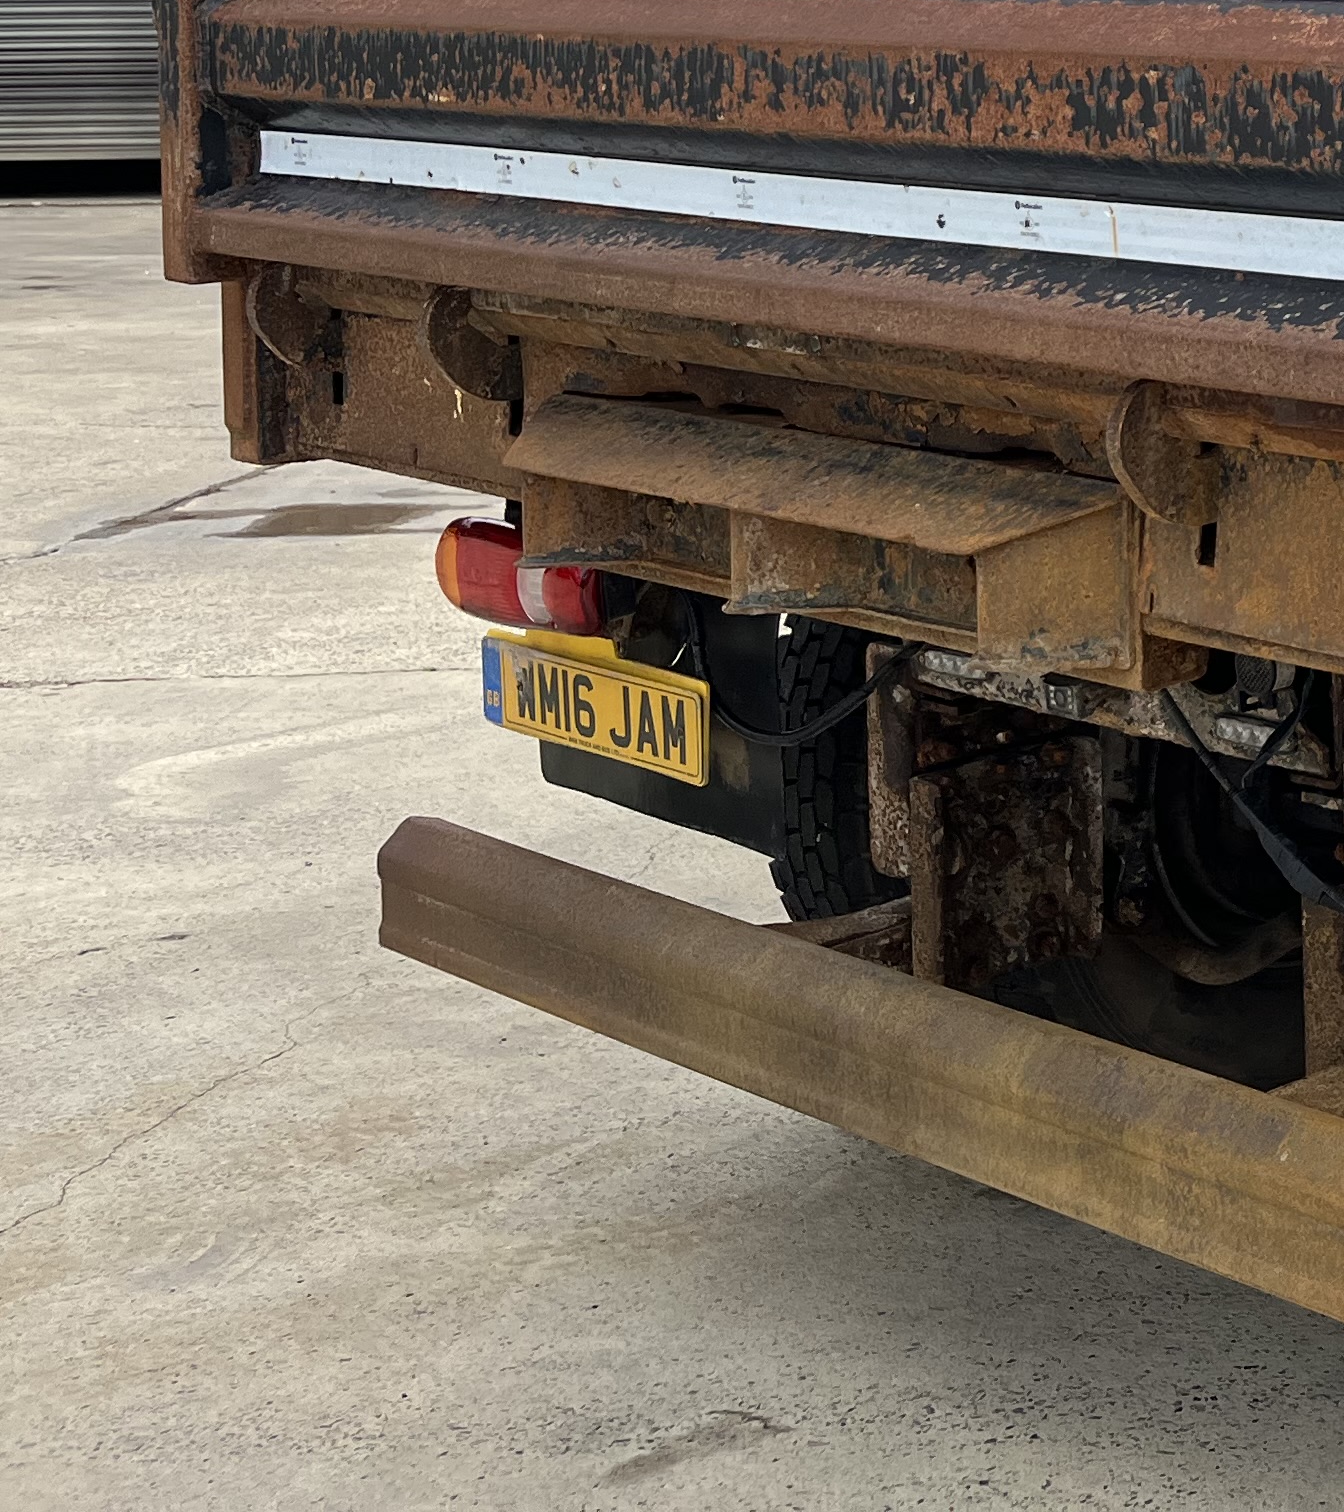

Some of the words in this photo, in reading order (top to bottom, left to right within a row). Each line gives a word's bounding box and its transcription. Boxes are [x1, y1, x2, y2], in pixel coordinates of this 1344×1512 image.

[486, 688, 500, 708] GB
[515, 660, 596, 738] WM16
[610, 685, 687, 766] JAM
